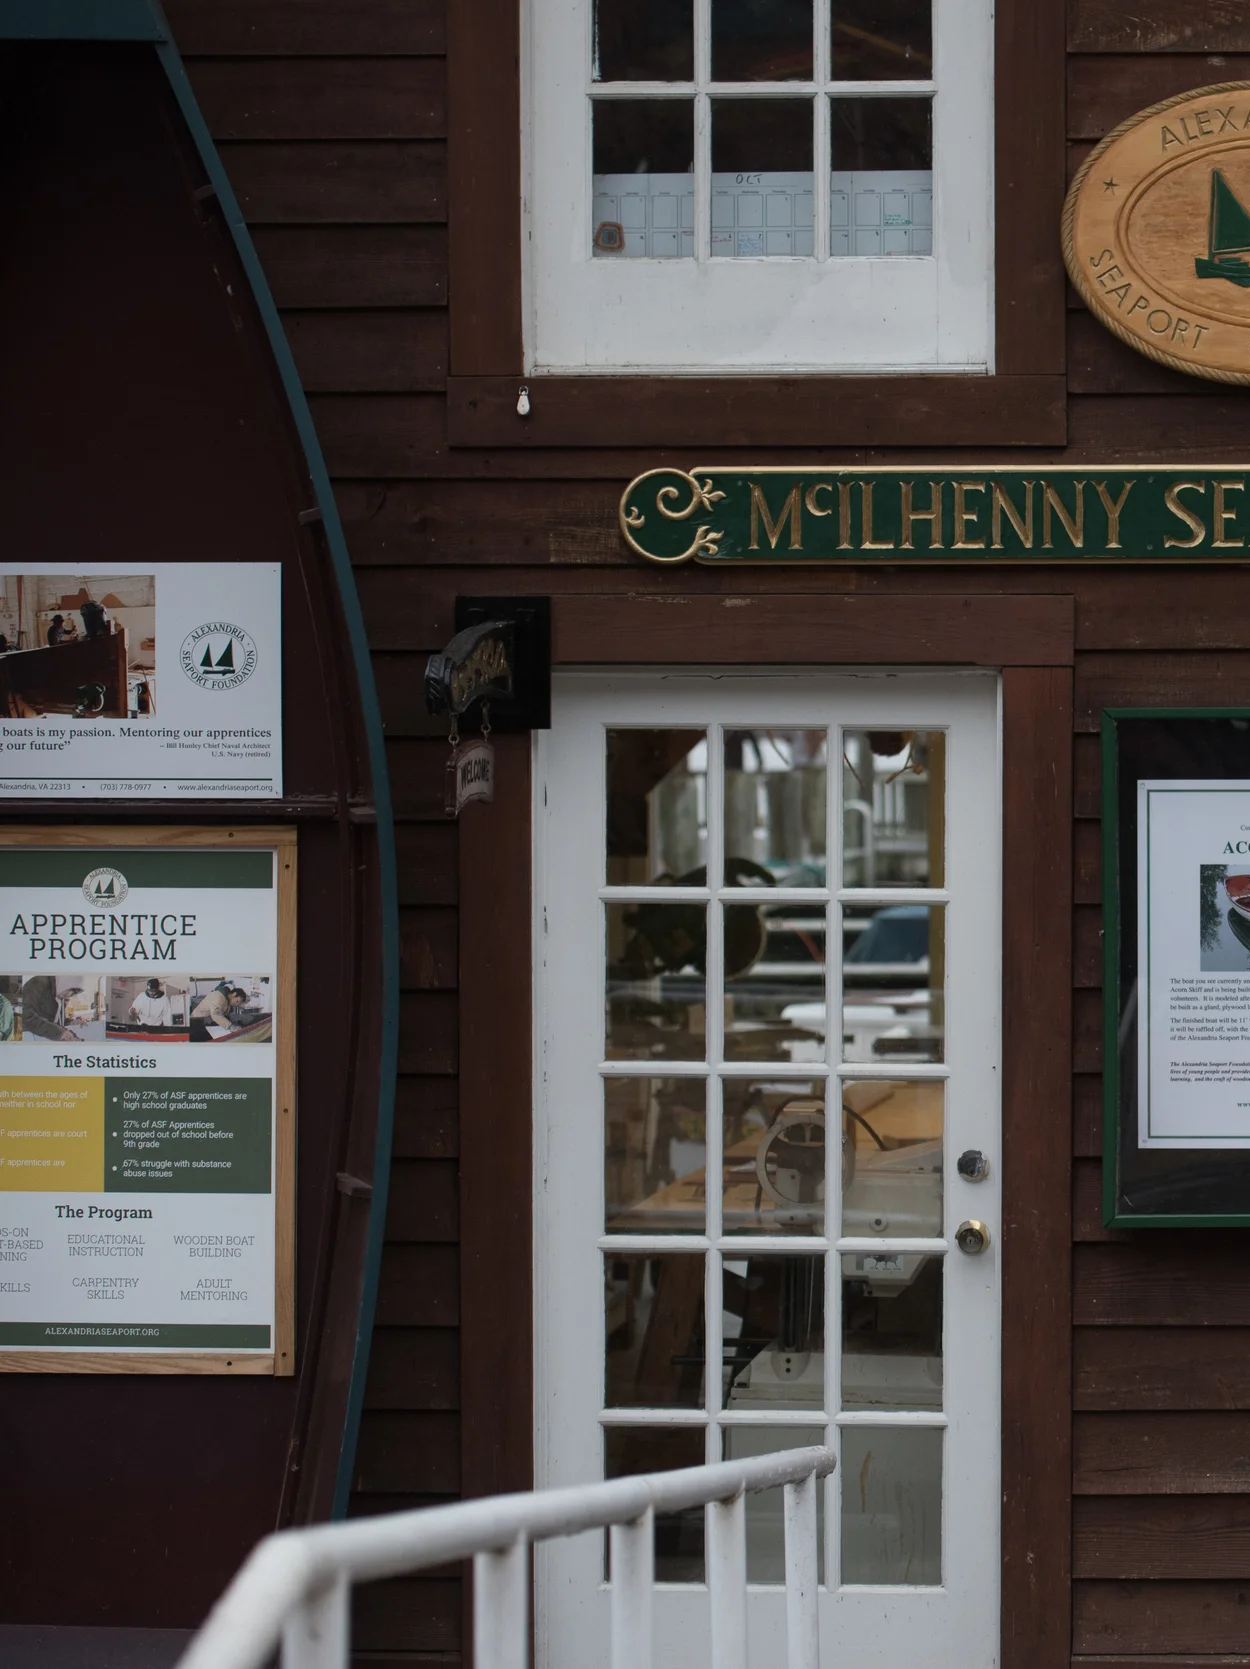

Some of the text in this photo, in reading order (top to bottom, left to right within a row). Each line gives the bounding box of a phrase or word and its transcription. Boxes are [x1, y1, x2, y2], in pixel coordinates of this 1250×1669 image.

[736, 173, 763, 184] OCT
[1089, 248, 1209, 350] SEAPORT
[191, 623, 246, 642] ALEXANDRIA
[182, 650, 255, 689] SEAPORT FOUNDATION
[2, 726, 34, 737] boats
[36, 727, 45, 737] is
[48, 729, 66, 740] my
[69, 727, 115, 740] passion.
[120, 727, 180, 740] Mentoring
[206, 727, 272, 740] apprentices
[6, 743, 27, 751] our
[178, 742, 201, 750] Hunley
[227, 751, 244, 759] Navy
[461, 758, 490, 790] WELCOME
[100, 783, 118, 791] (703)
[177, 784, 273, 792] www.alexandriaseaport.org
[9, 914, 196, 936] APPRENTICE
[29, 938, 177, 960] PROGRAM
[53, 1054, 157, 1069] The Statistics
[123, 1091, 141, 1102] Only
[142, 1091, 159, 1100] 27%
[160, 1091, 169, 1100] of
[170, 1091, 187, 1100] ASF
[188, 1092, 233, 1101] apprentices
[123, 1101, 207, 1111] high school graduates
[123, 1120, 215, 1131] 27% of ASF Apprentices
[123, 1130, 155, 1140] dropped
[171, 1130, 180, 1138] of
[181, 1130, 207, 1139] school
[209, 1130, 234, 1139] before
[123, 1139, 160, 1150] 9th grade
[123, 1159, 232, 1169] 67% struggle with substance
[123, 1169, 173, 1178] abuse issues
[55, 1204, 153, 1222] The Program
[67, 1234, 145, 1245] EDUCATIONAL
[173, 1235, 255, 1246] WOODEN BOAT
[68, 1246, 144, 1257] INSTRUCTION
[189, 1247, 242, 1258] BUILDING
[72, 1277, 139, 1288] CARPENTRY
[196, 1279, 233, 1289] ADULT
[87, 1289, 125, 1300] SKILLS
[180, 1291, 248, 1301] MENTORING
[45, 1327, 160, 1336] ALEXANDRIASEAPORT.ORG
